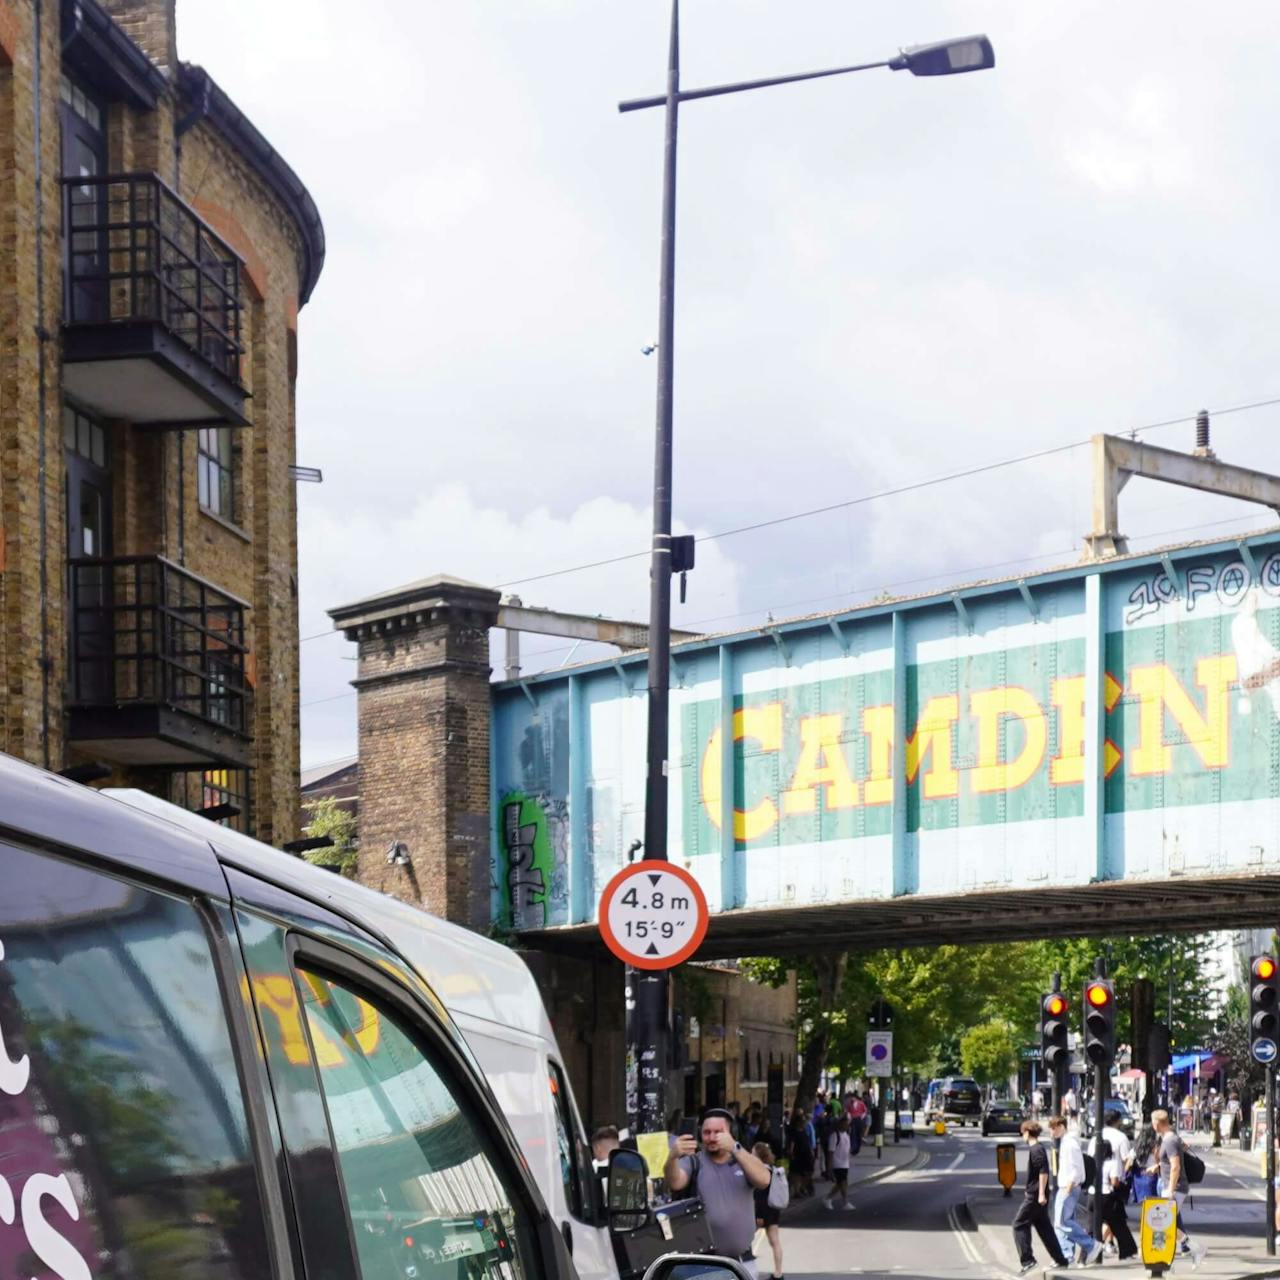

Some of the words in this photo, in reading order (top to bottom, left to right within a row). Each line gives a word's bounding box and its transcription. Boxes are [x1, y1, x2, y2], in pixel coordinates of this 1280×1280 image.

[700, 654, 1238, 843] CAMDEN
[620, 887, 664, 909] 4.8
[671, 897, 689, 910] m
